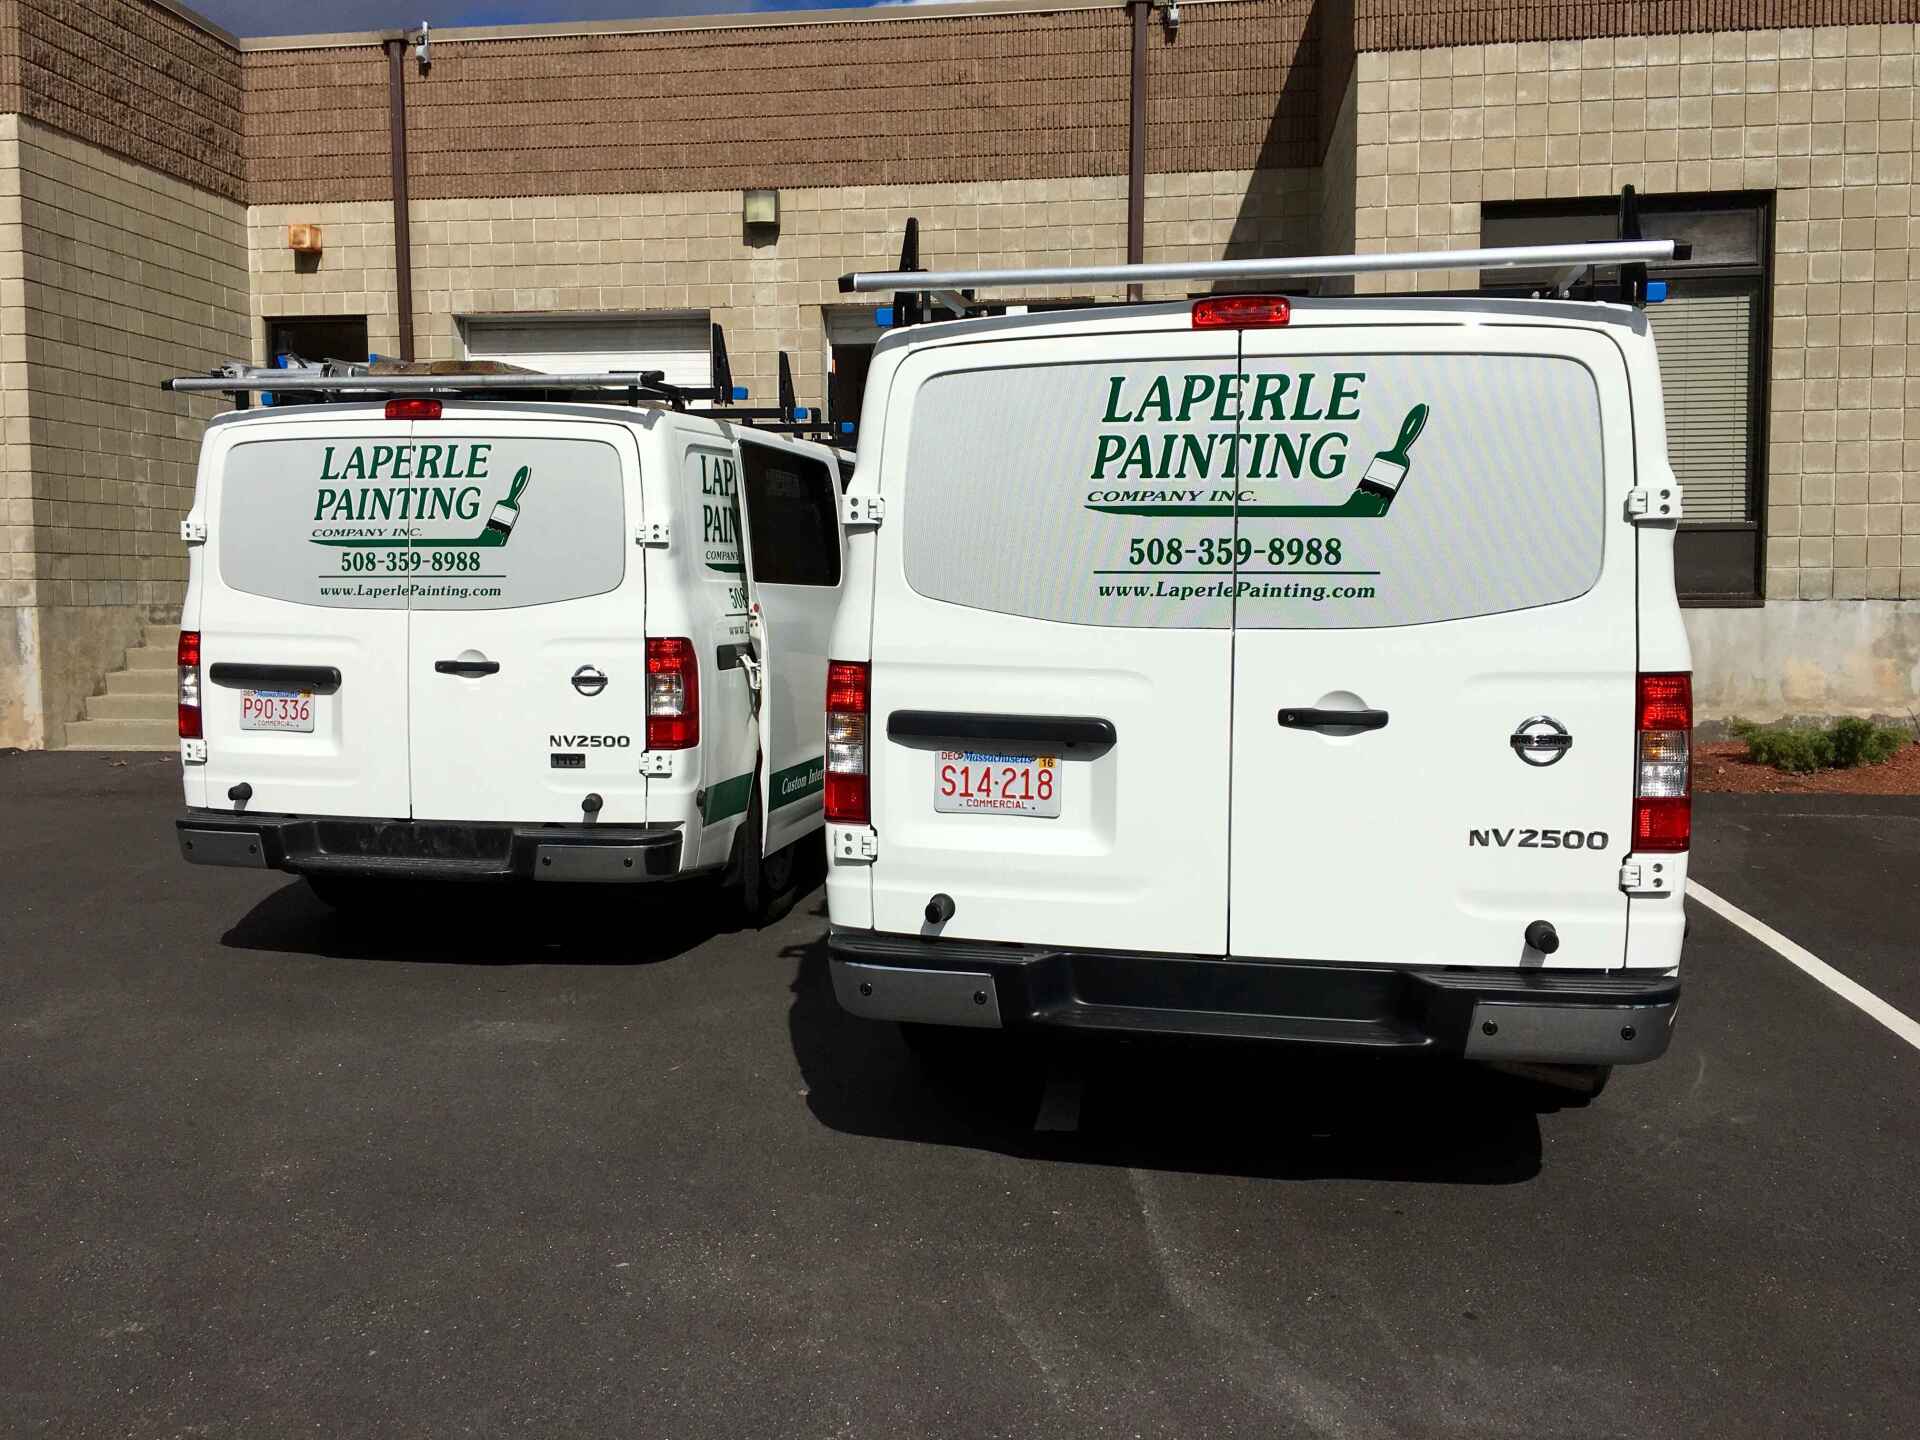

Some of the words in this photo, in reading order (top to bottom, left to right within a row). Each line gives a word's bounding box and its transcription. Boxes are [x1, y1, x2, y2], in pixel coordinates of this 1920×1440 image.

[1101, 372, 1366, 423] LAPERLE
[319, 444, 492, 481] LAPERLE
[1090, 432, 1349, 480] PAINTING
[313, 486, 481, 521] PAINTING
[1087, 490, 1205, 502] COMPANY
[1209, 490, 1257, 502] INC.
[311, 528, 388, 538] COMPANY
[392, 527, 423, 537] INC.
[341, 551, 481, 572] 508-359-8988
[1129, 538, 1342, 566] 508-359-8988
[320, 584, 502, 598] www.LaperlePainting.com
[1099, 581, 1375, 601] www.LaperlePainting.com
[549, 734, 631, 748] NV2500
[781, 775, 807, 795] Custom
[966, 798, 1028, 810] COMMERCIAL
[1468, 828, 1610, 851] NV2500
